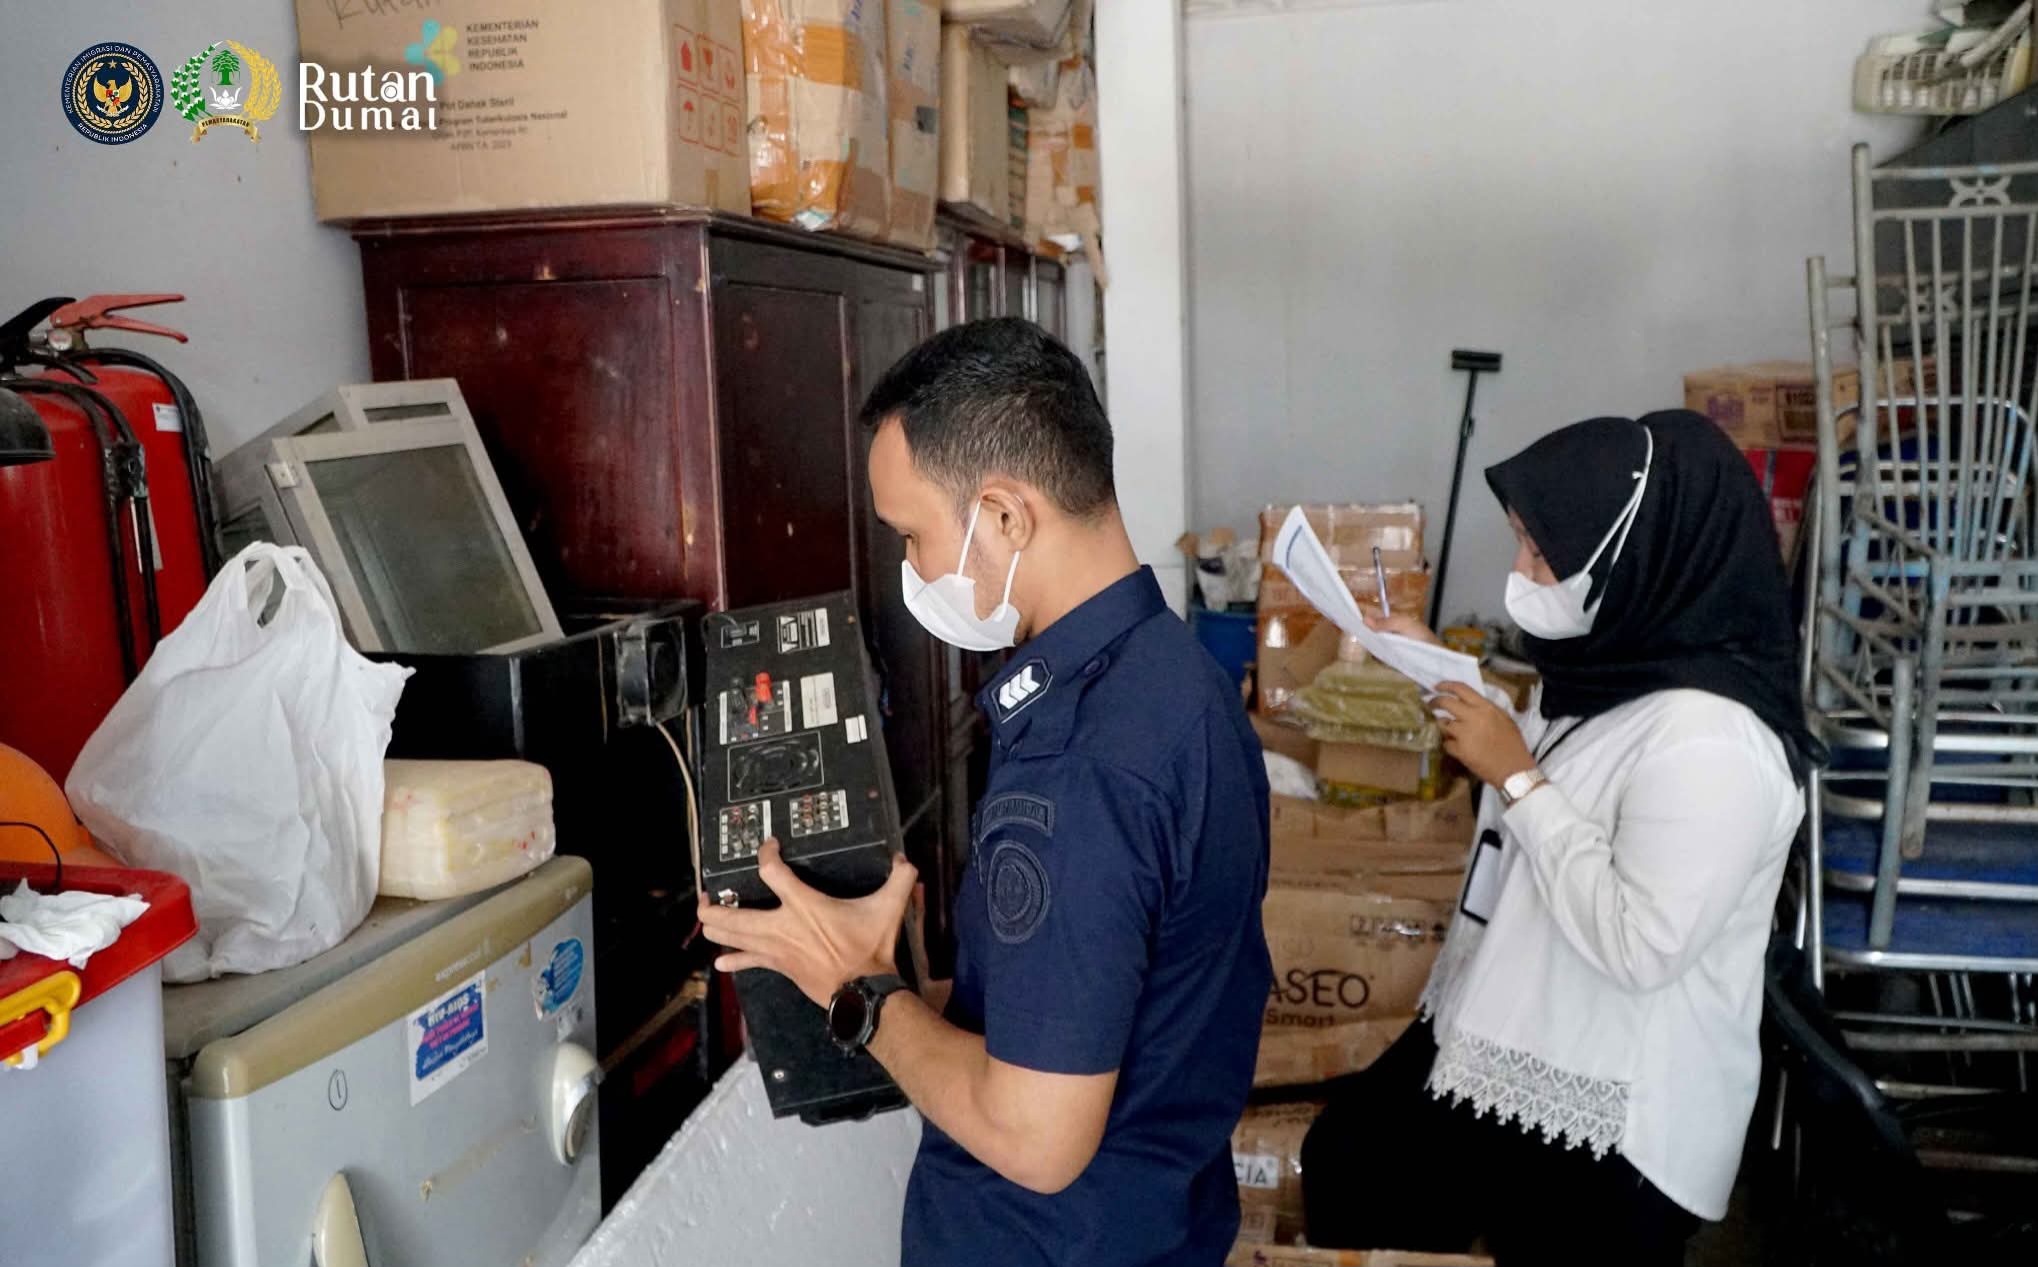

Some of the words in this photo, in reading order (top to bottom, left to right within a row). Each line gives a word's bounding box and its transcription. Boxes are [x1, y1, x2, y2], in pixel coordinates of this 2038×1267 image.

[466, 19, 539, 33] KEMENTERIAN
[467, 34, 528, 47] KESEHATAN
[468, 47, 518, 59] REPUBLIK
[469, 59, 525, 72] INDONESIA
[1266, 1008, 1336, 1028] Smart
